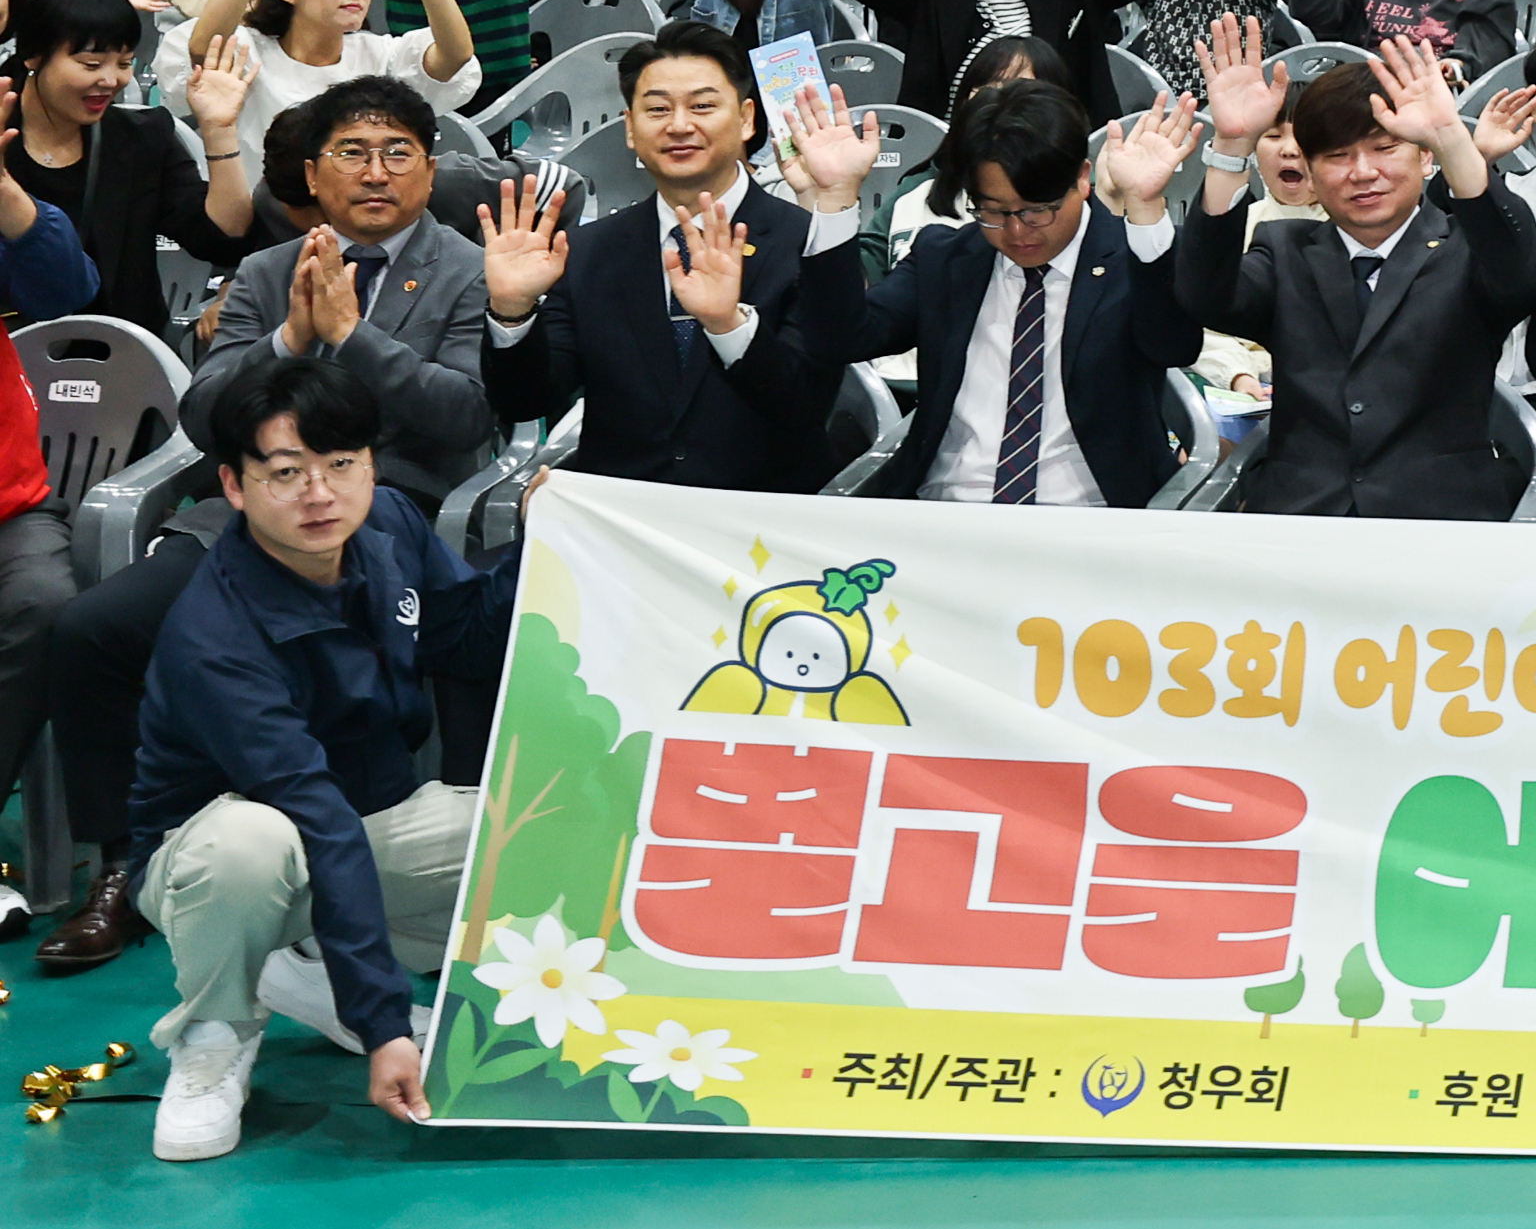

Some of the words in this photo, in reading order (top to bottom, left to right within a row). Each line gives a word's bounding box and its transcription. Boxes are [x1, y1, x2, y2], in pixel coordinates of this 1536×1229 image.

[55, 385, 95, 399] 내빈석
[1016, 616, 1306, 728] 103회
[633, 735, 1308, 980] 별고을
[832, 1052, 1036, 1103] 주최/주관
[1158, 1062, 1291, 1111] 청우회
[1435, 1070, 1524, 1118] 후원
